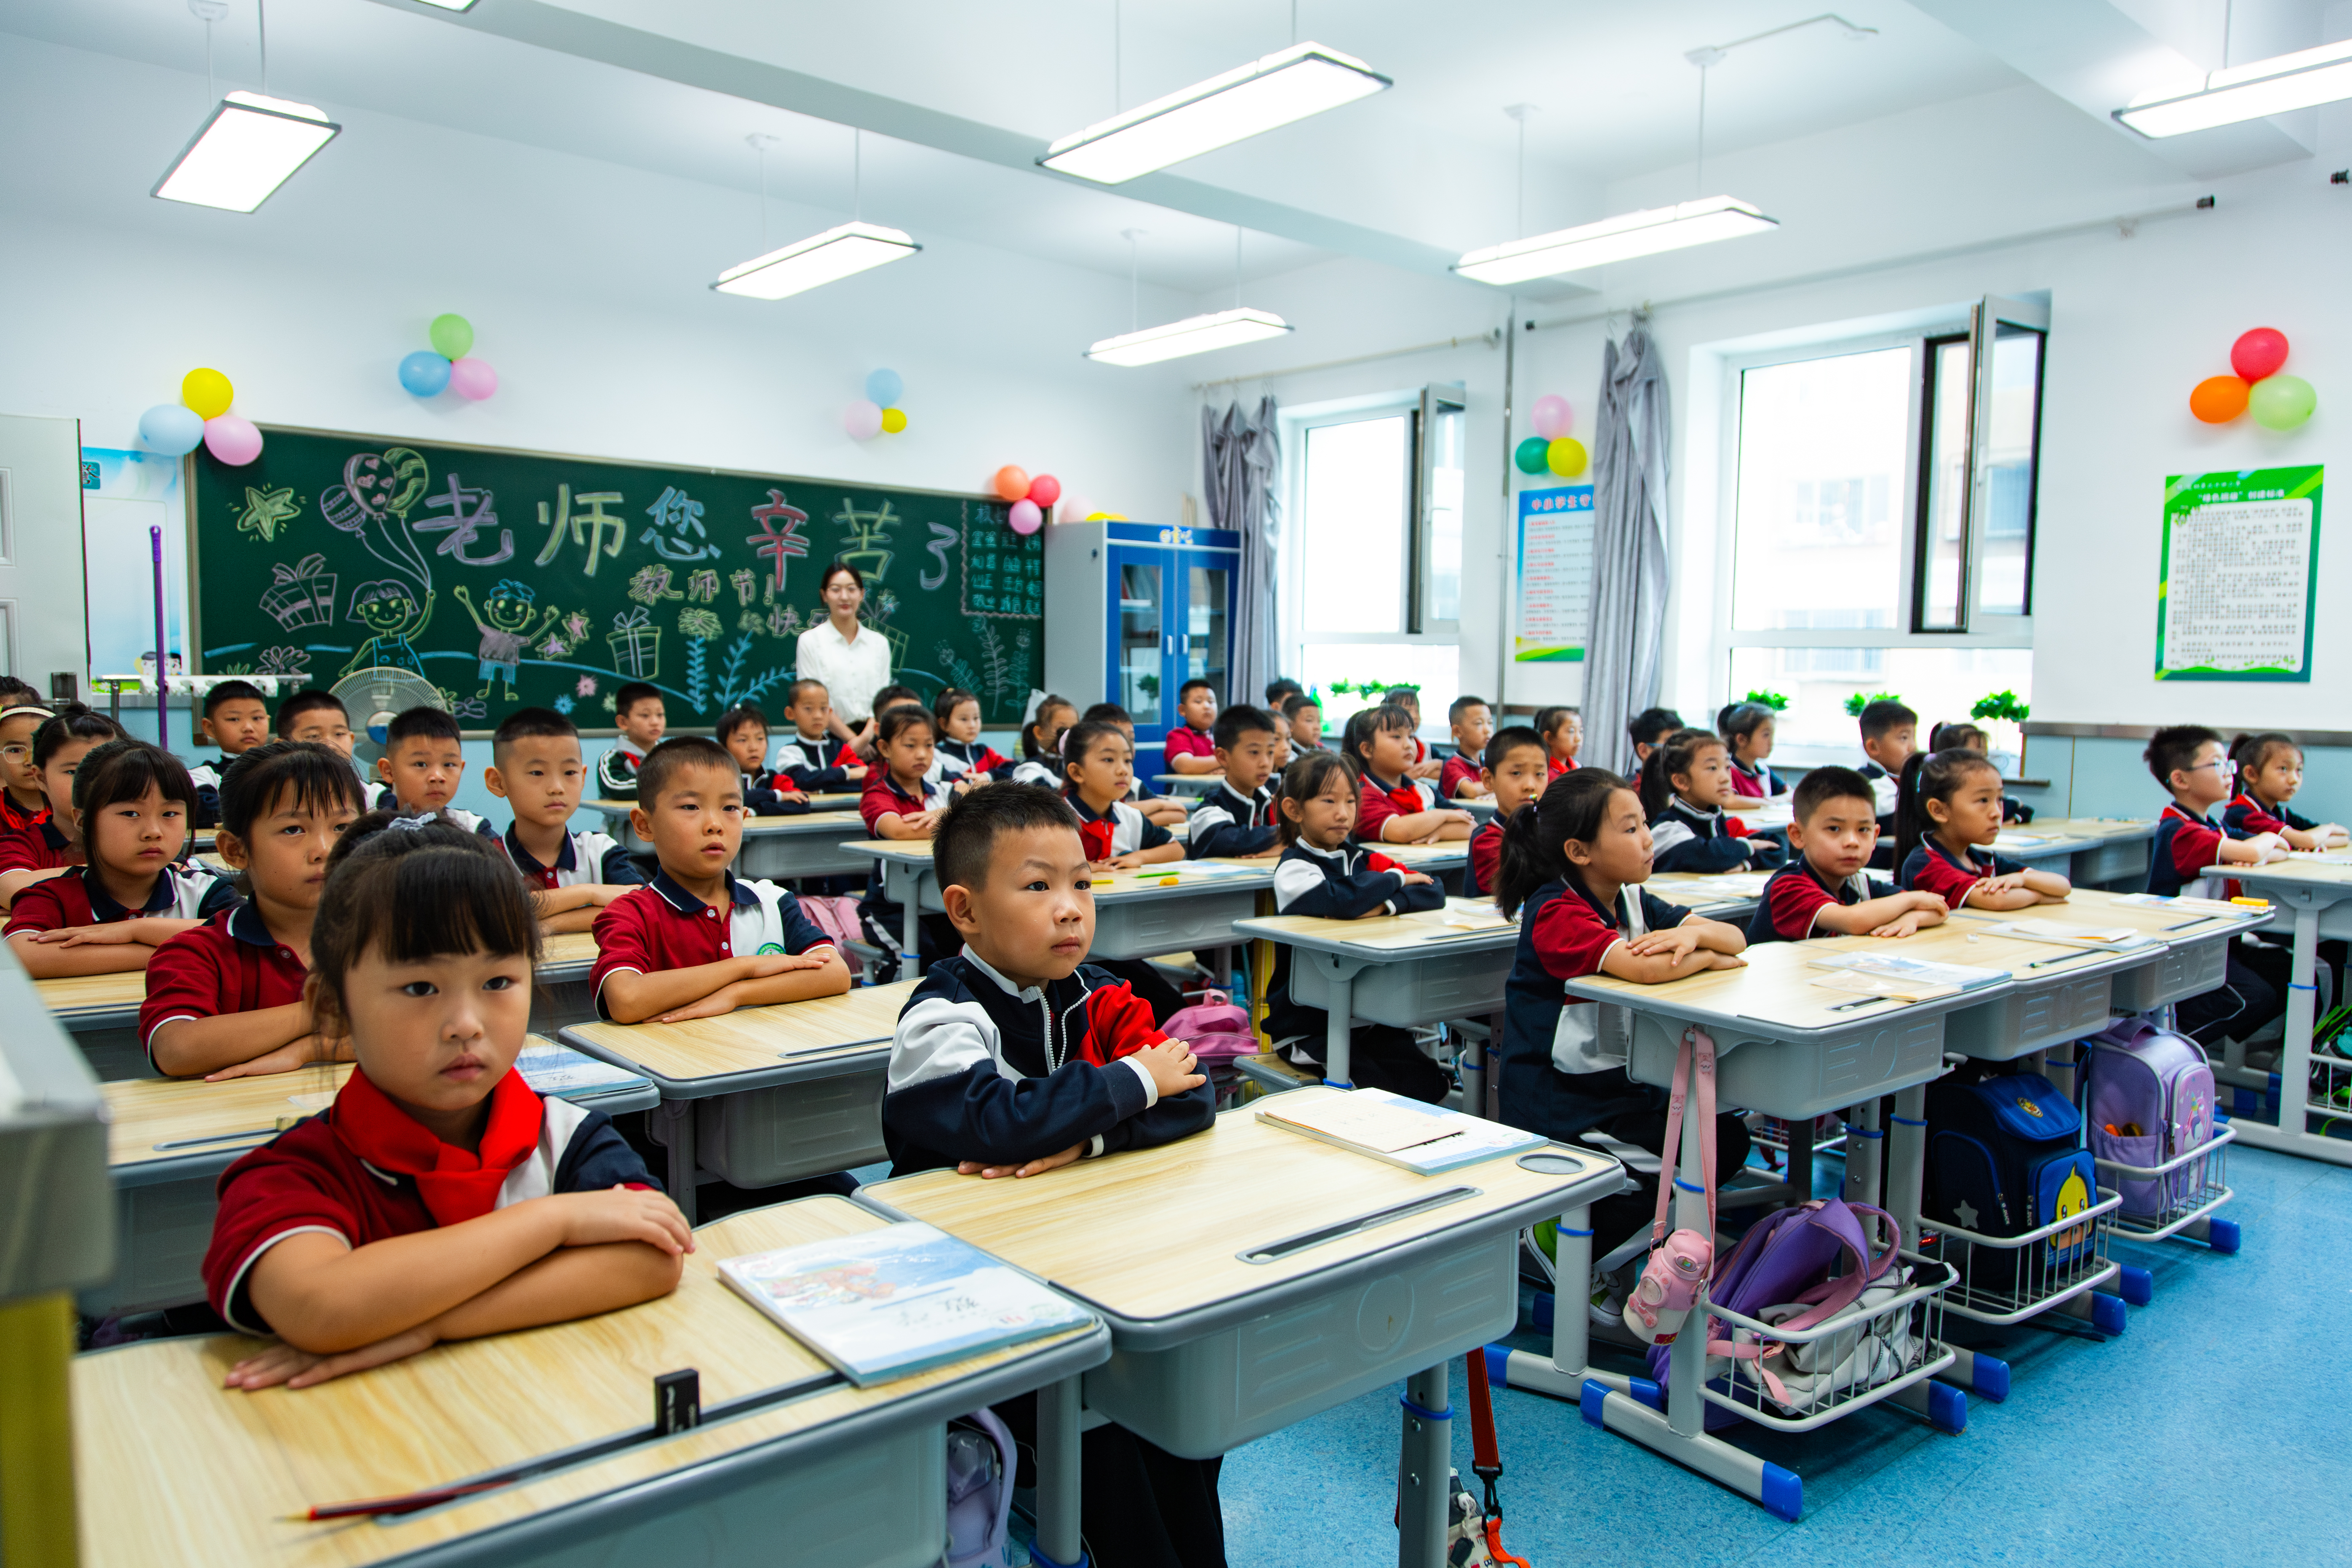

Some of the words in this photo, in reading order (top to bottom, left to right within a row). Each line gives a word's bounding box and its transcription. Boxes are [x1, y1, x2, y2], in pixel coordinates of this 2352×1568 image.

[412, 472, 960, 591] 老师您辛苦了
[1531, 493, 1595, 511] 中小学生守
